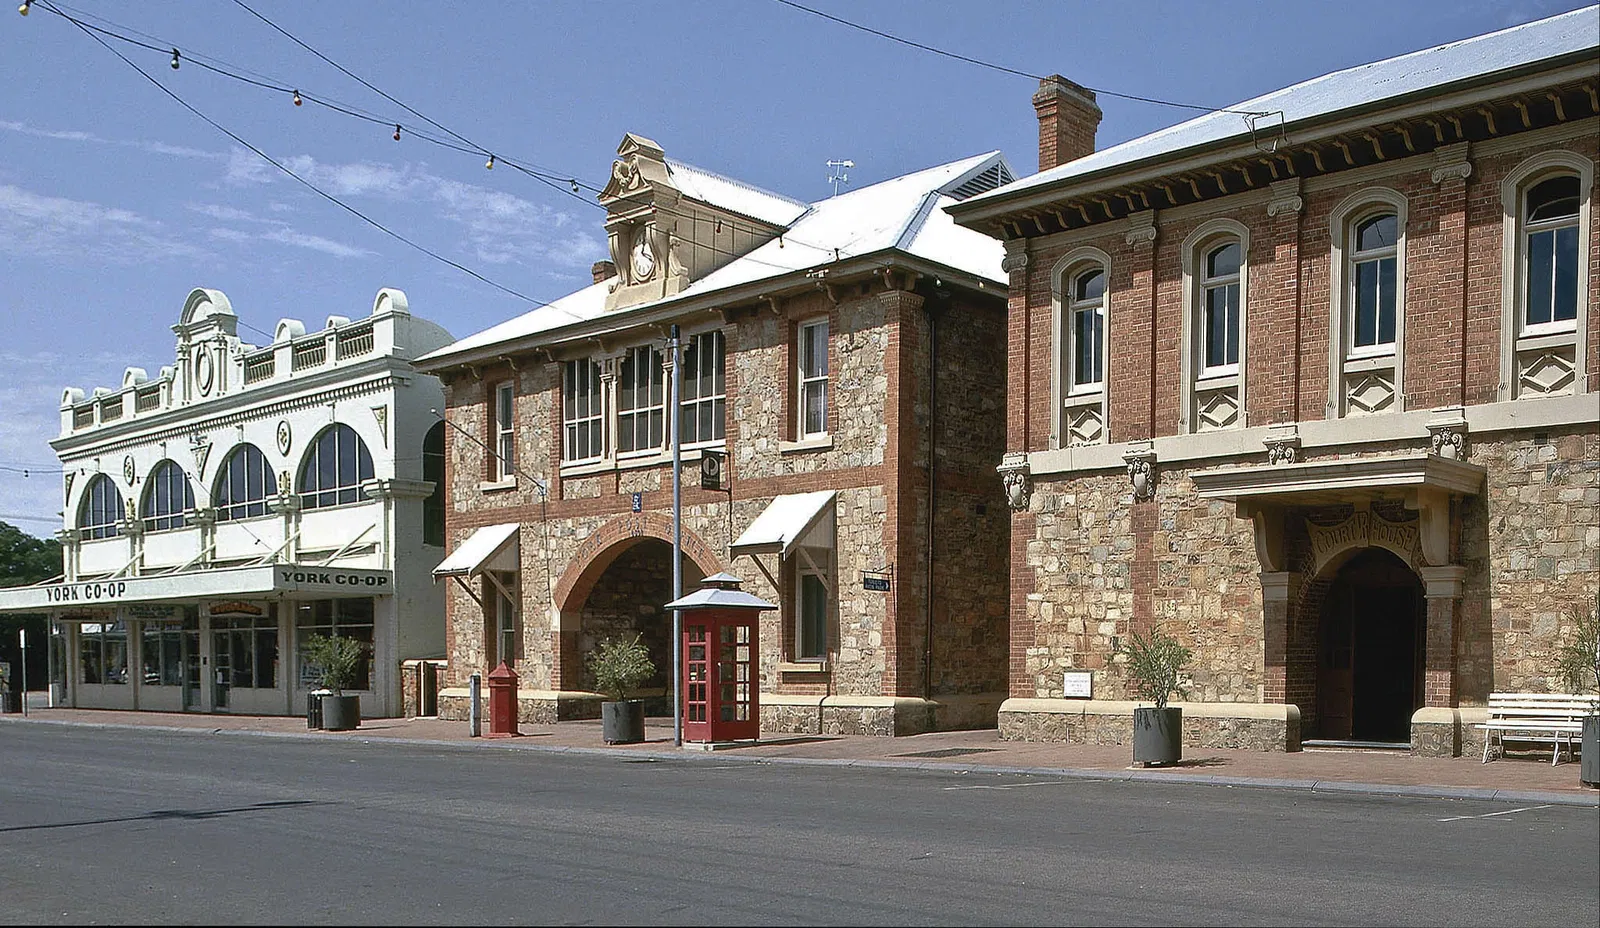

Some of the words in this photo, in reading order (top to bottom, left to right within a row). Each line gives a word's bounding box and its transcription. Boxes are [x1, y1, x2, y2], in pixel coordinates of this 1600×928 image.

[618, 517, 647, 534] POST
[1317, 526, 1355, 553] COURT
[1372, 520, 1416, 552] HOUSE
[281, 572, 331, 584] YORK
[335, 574, 388, 586] CO-OP
[46, 586, 79, 602] YORK
